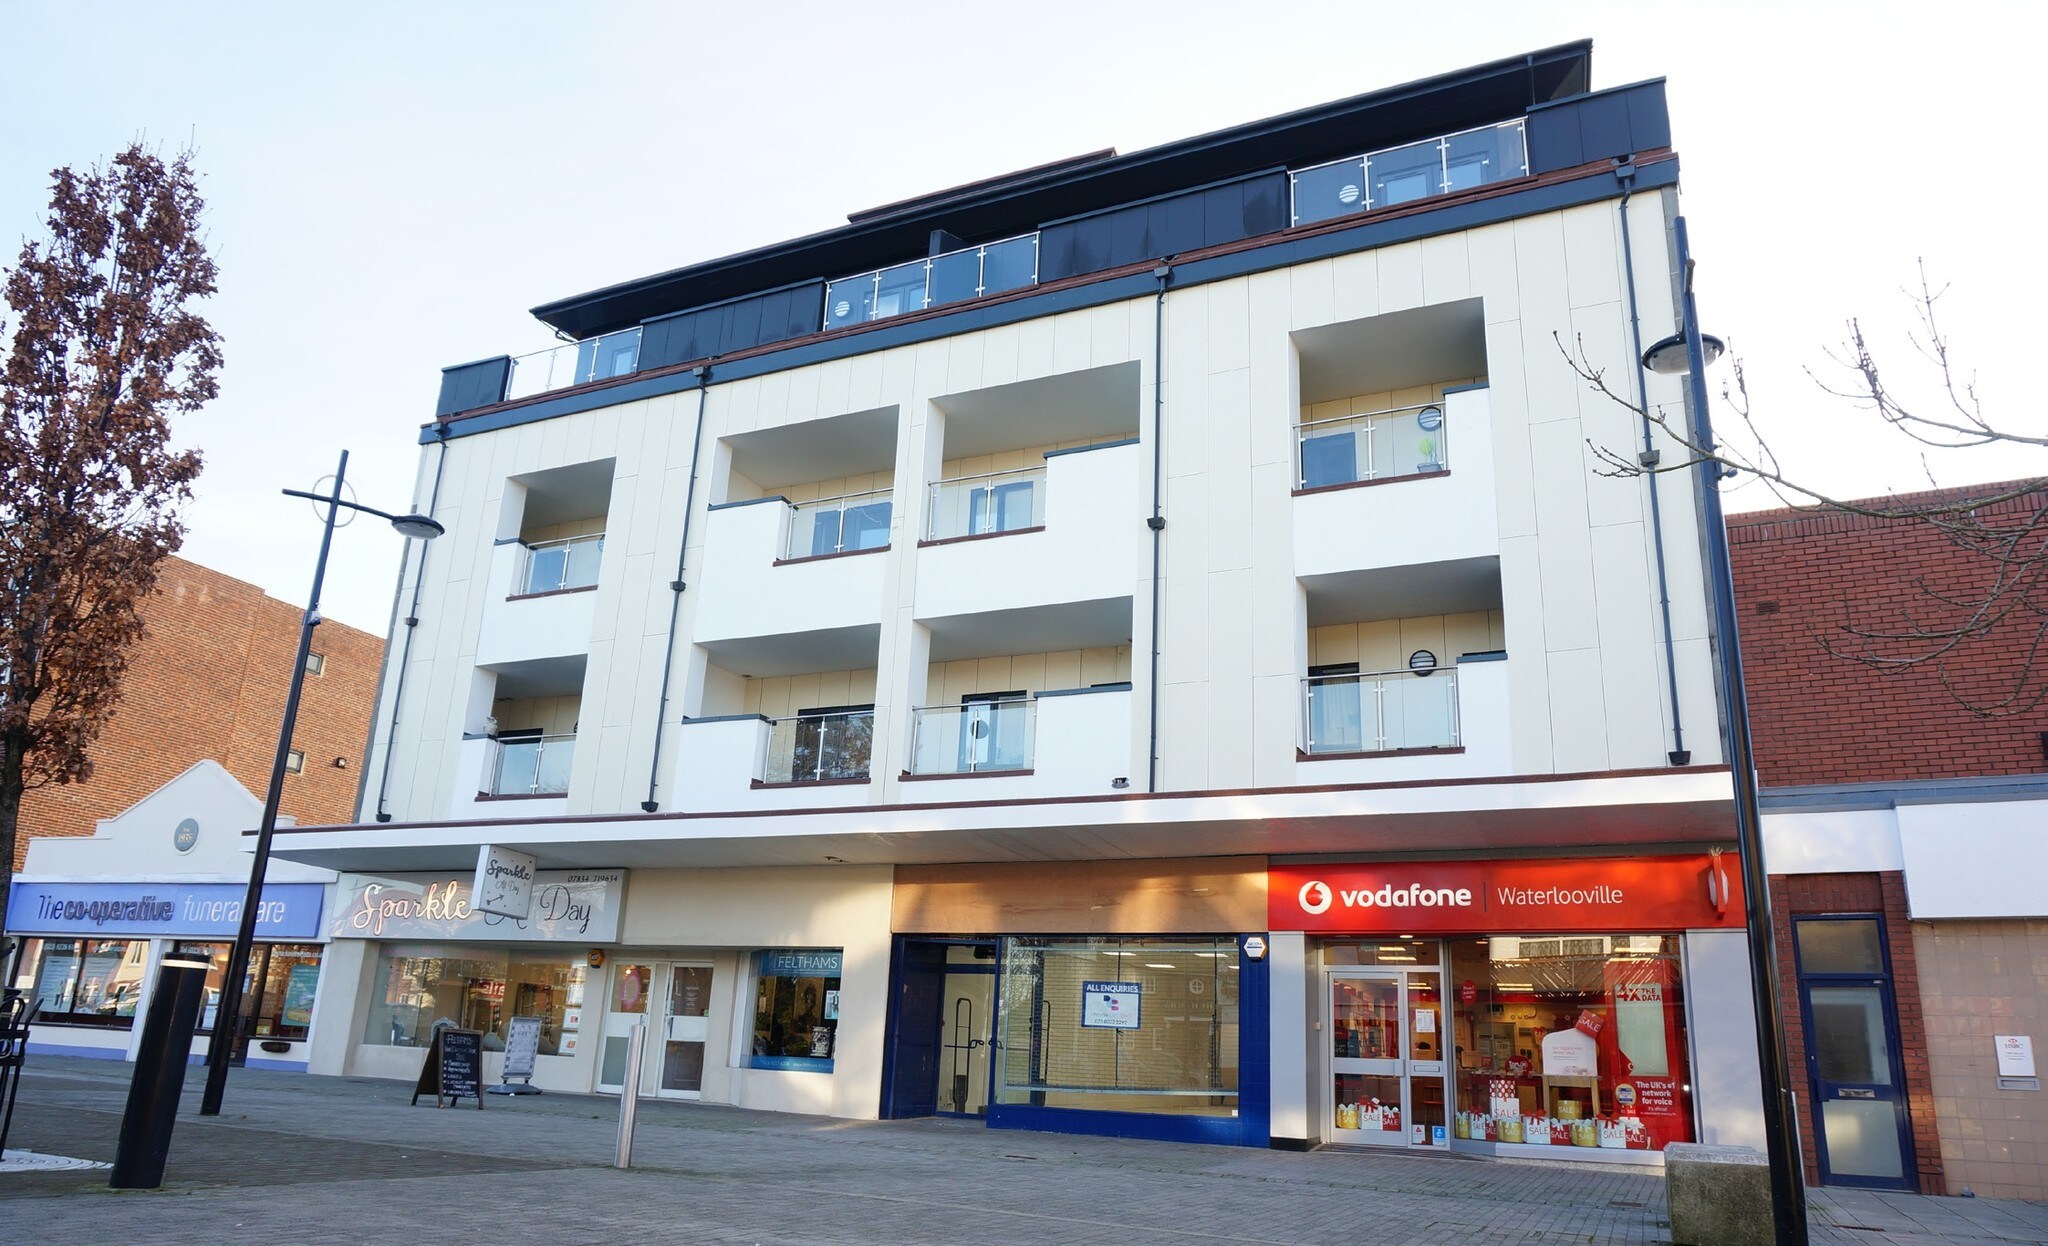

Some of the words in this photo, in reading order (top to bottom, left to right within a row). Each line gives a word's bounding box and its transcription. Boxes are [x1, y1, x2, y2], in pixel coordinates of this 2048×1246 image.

[486, 859, 532, 881] Sparkle
[1340, 884, 1472, 908] vodafone
[1497, 886, 1624, 905] Waterlooville
[353, 879, 473, 935] Sparkle
[540, 884, 591, 934] Day
[778, 956, 838, 969] FELTHAMS
[1086, 983, 1100, 991] ALL
[1100, 984, 1139, 993] ENQUIRIES
[1641, 987, 1656, 995] THE
[1578, 1016, 1601, 1033] SALE
[1650, 1081, 1667, 1089] UK's
[1642, 1097, 1652, 1105] for
[1558, 1106, 1574, 1114] SALE
[1472, 1122, 1486, 1130] SALE
[1529, 1126, 1549, 1134] SALE
[1550, 1130, 1568, 1139] SALE
[1603, 1130, 1624, 1139] SALE
[1626, 1134, 1645, 1142] SALE
